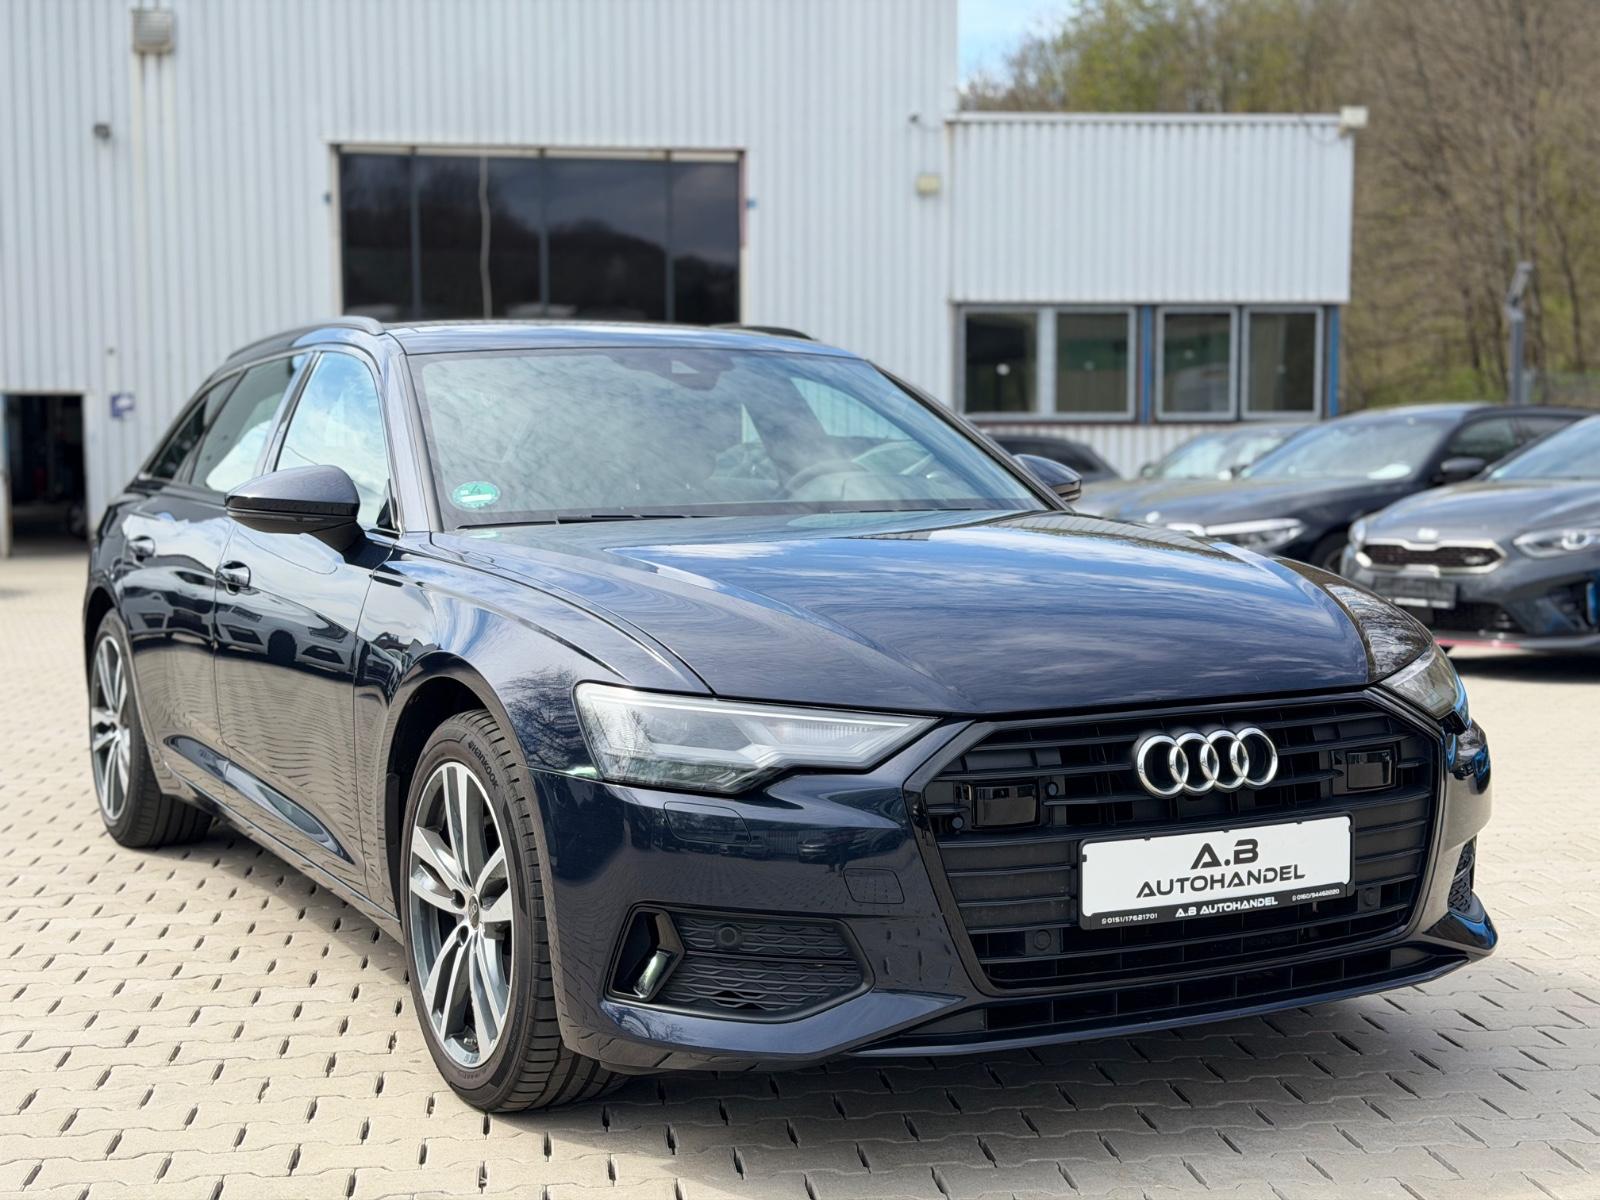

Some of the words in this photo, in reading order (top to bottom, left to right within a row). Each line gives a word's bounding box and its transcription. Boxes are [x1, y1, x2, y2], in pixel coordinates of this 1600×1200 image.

[1191, 838, 1259, 870] A.B
[1136, 864, 1305, 898] AUTOHANDEL
[1175, 906, 1196, 918] A.B
[1199, 896, 1278, 915] AUTOHANDEL
